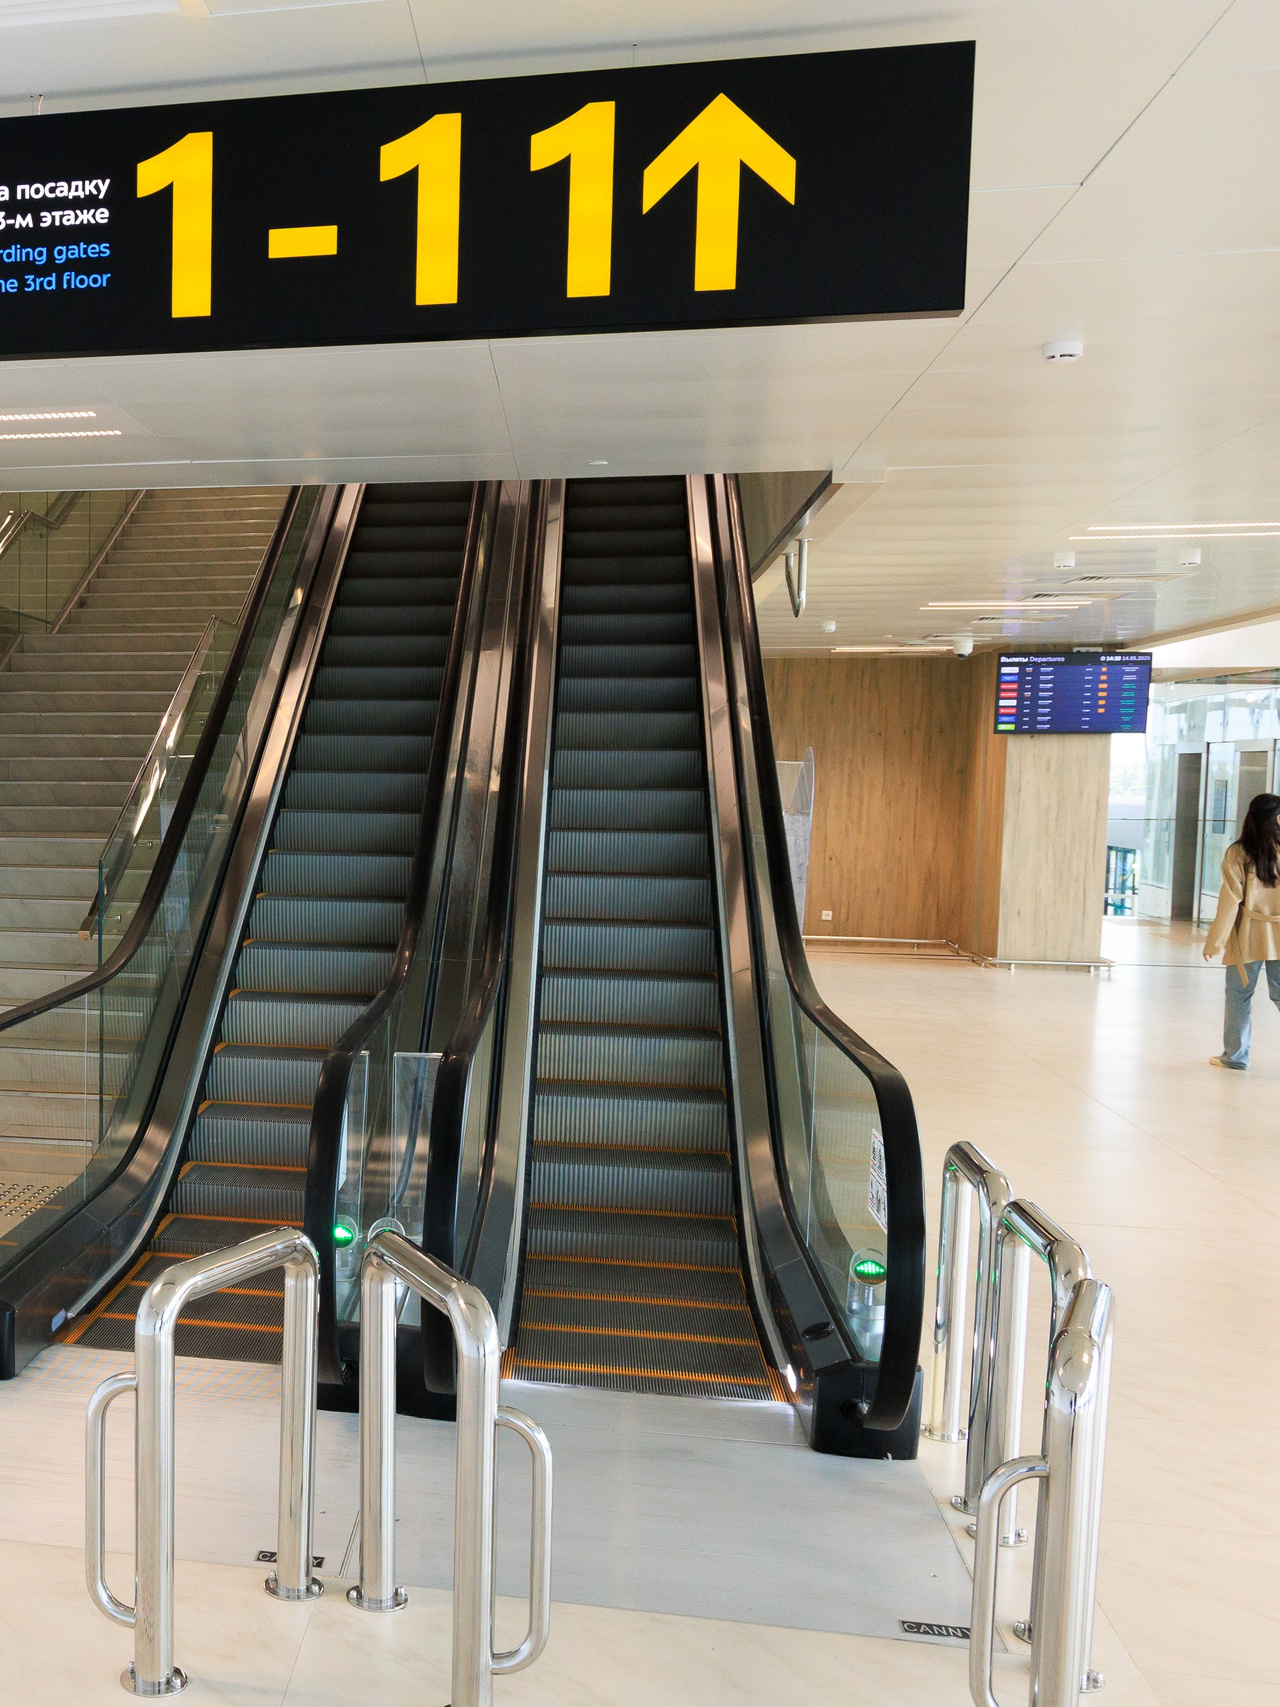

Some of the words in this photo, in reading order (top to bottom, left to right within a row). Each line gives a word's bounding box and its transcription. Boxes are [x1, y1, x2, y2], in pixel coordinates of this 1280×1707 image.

[17, 178, 110, 200] посадку
[40, 207, 109, 228] этаже
[136, 131, 213, 319] 1
[54, 241, 110, 264] gates
[24, 272, 56, 291] 3rd
[62, 271, 111, 289] floor
